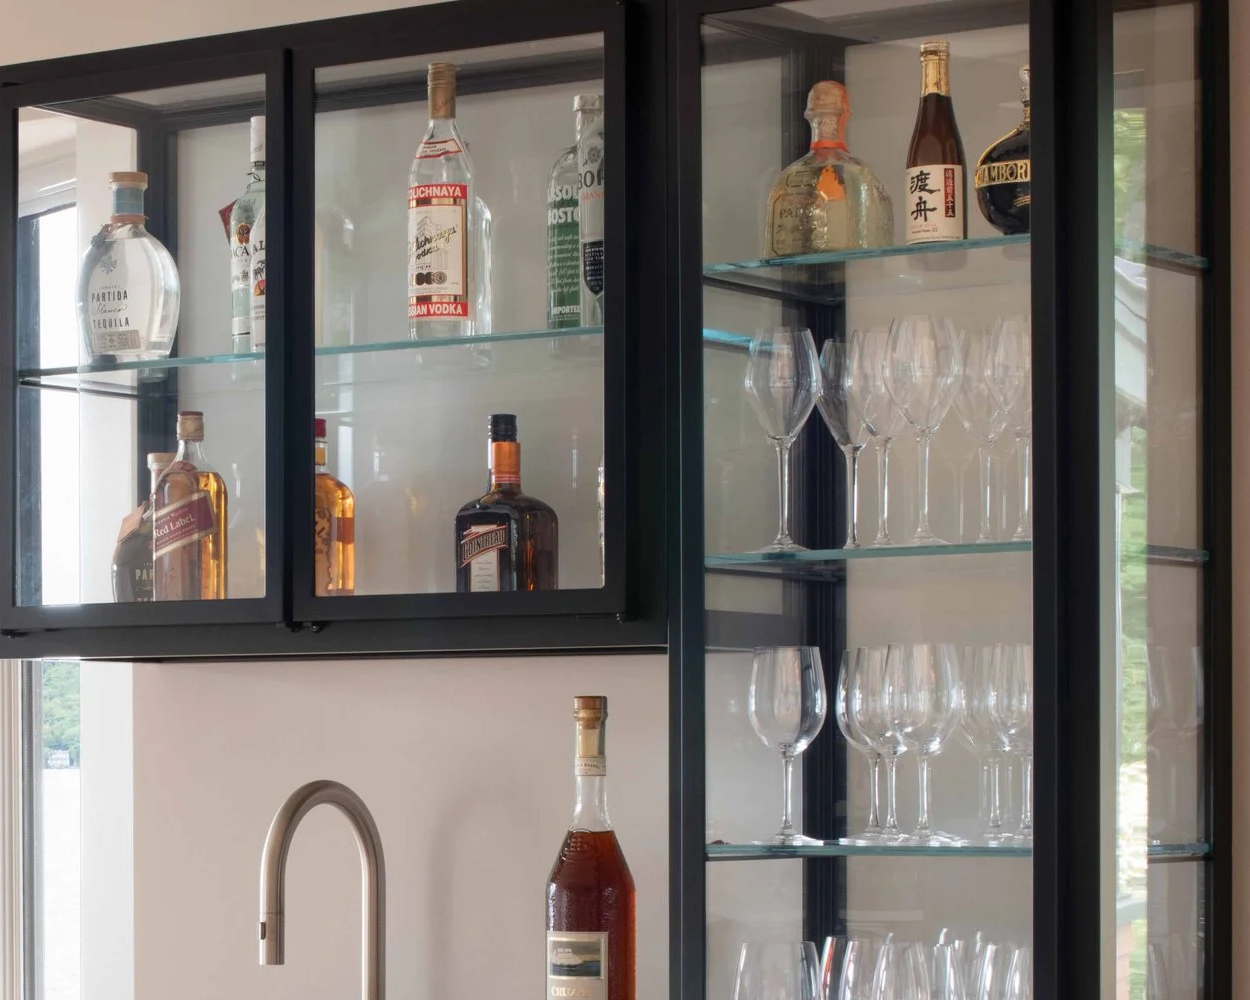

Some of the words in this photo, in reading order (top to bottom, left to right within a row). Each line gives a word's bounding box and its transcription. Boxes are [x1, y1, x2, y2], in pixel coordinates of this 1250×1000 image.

[910, 170, 940, 222] 渡舟
[91, 290, 128, 303] PARTIDA
[429, 303, 463, 315] VODKA
[92, 317, 130, 329] TEQUILA
[462, 530, 506, 563] COINTREAU
